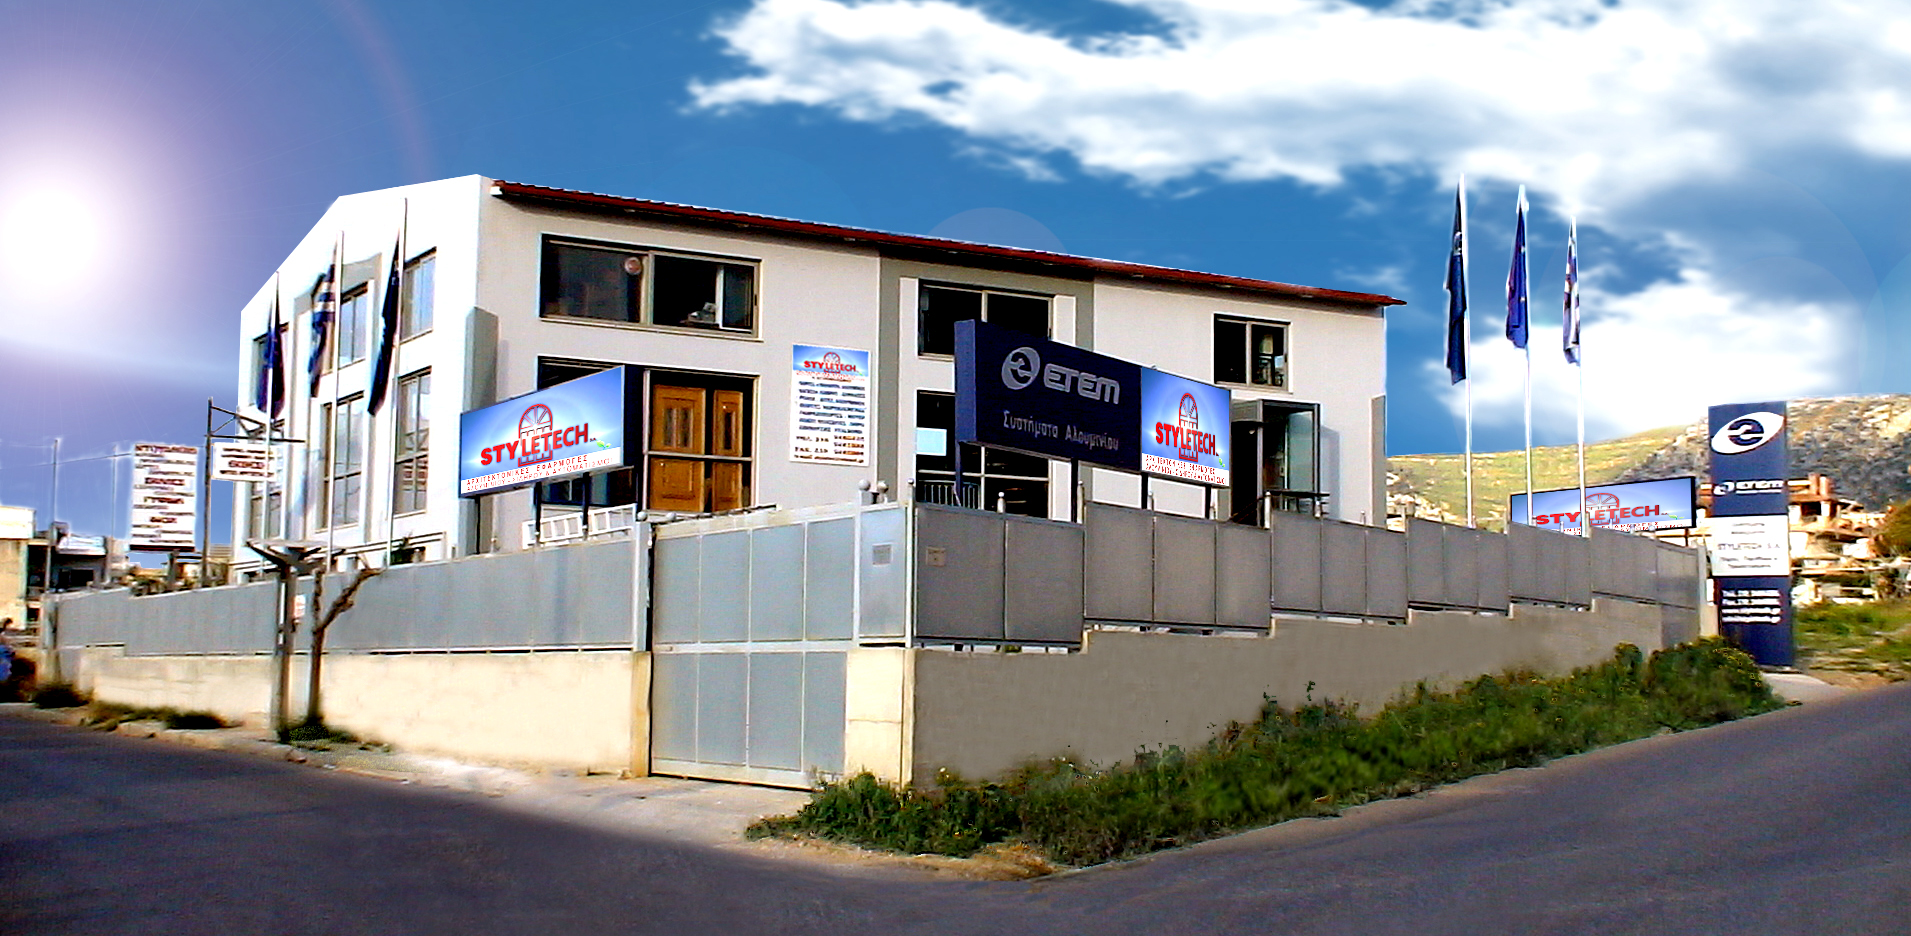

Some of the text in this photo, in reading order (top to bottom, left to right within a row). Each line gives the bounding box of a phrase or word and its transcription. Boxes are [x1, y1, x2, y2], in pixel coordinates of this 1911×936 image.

[804, 360, 856, 372] STYLETECH
[1043, 363, 1120, 404] ETEM
[1003, 409, 1059, 438] Συστήματα
[1156, 421, 1216, 456] STYLETECH
[481, 423, 589, 466] STYLETECH
[1536, 504, 1660, 525] STYETECH
